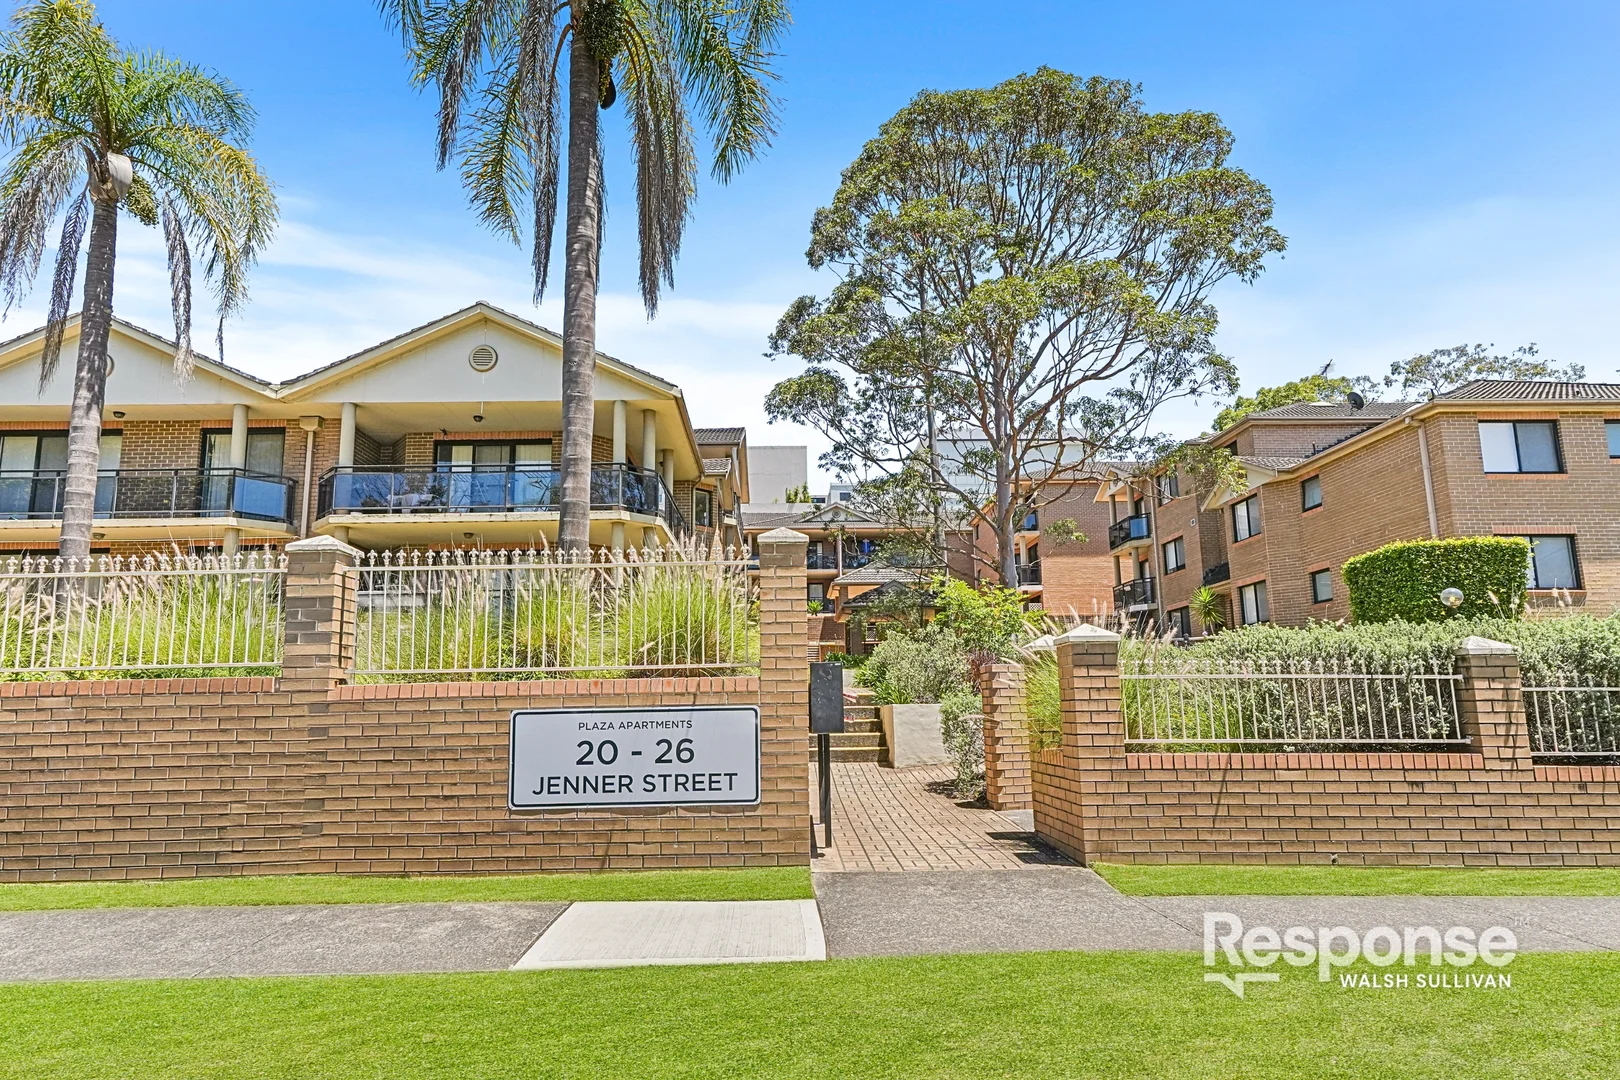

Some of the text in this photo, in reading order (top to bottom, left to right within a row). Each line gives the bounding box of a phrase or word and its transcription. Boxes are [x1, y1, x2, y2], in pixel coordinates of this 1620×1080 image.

[578, 720, 693, 731] PLAZA APARTMENTS
[576, 740, 619, 766] 20
[654, 738, 695, 764] 26
[532, 772, 738, 795] JENNER STREET
